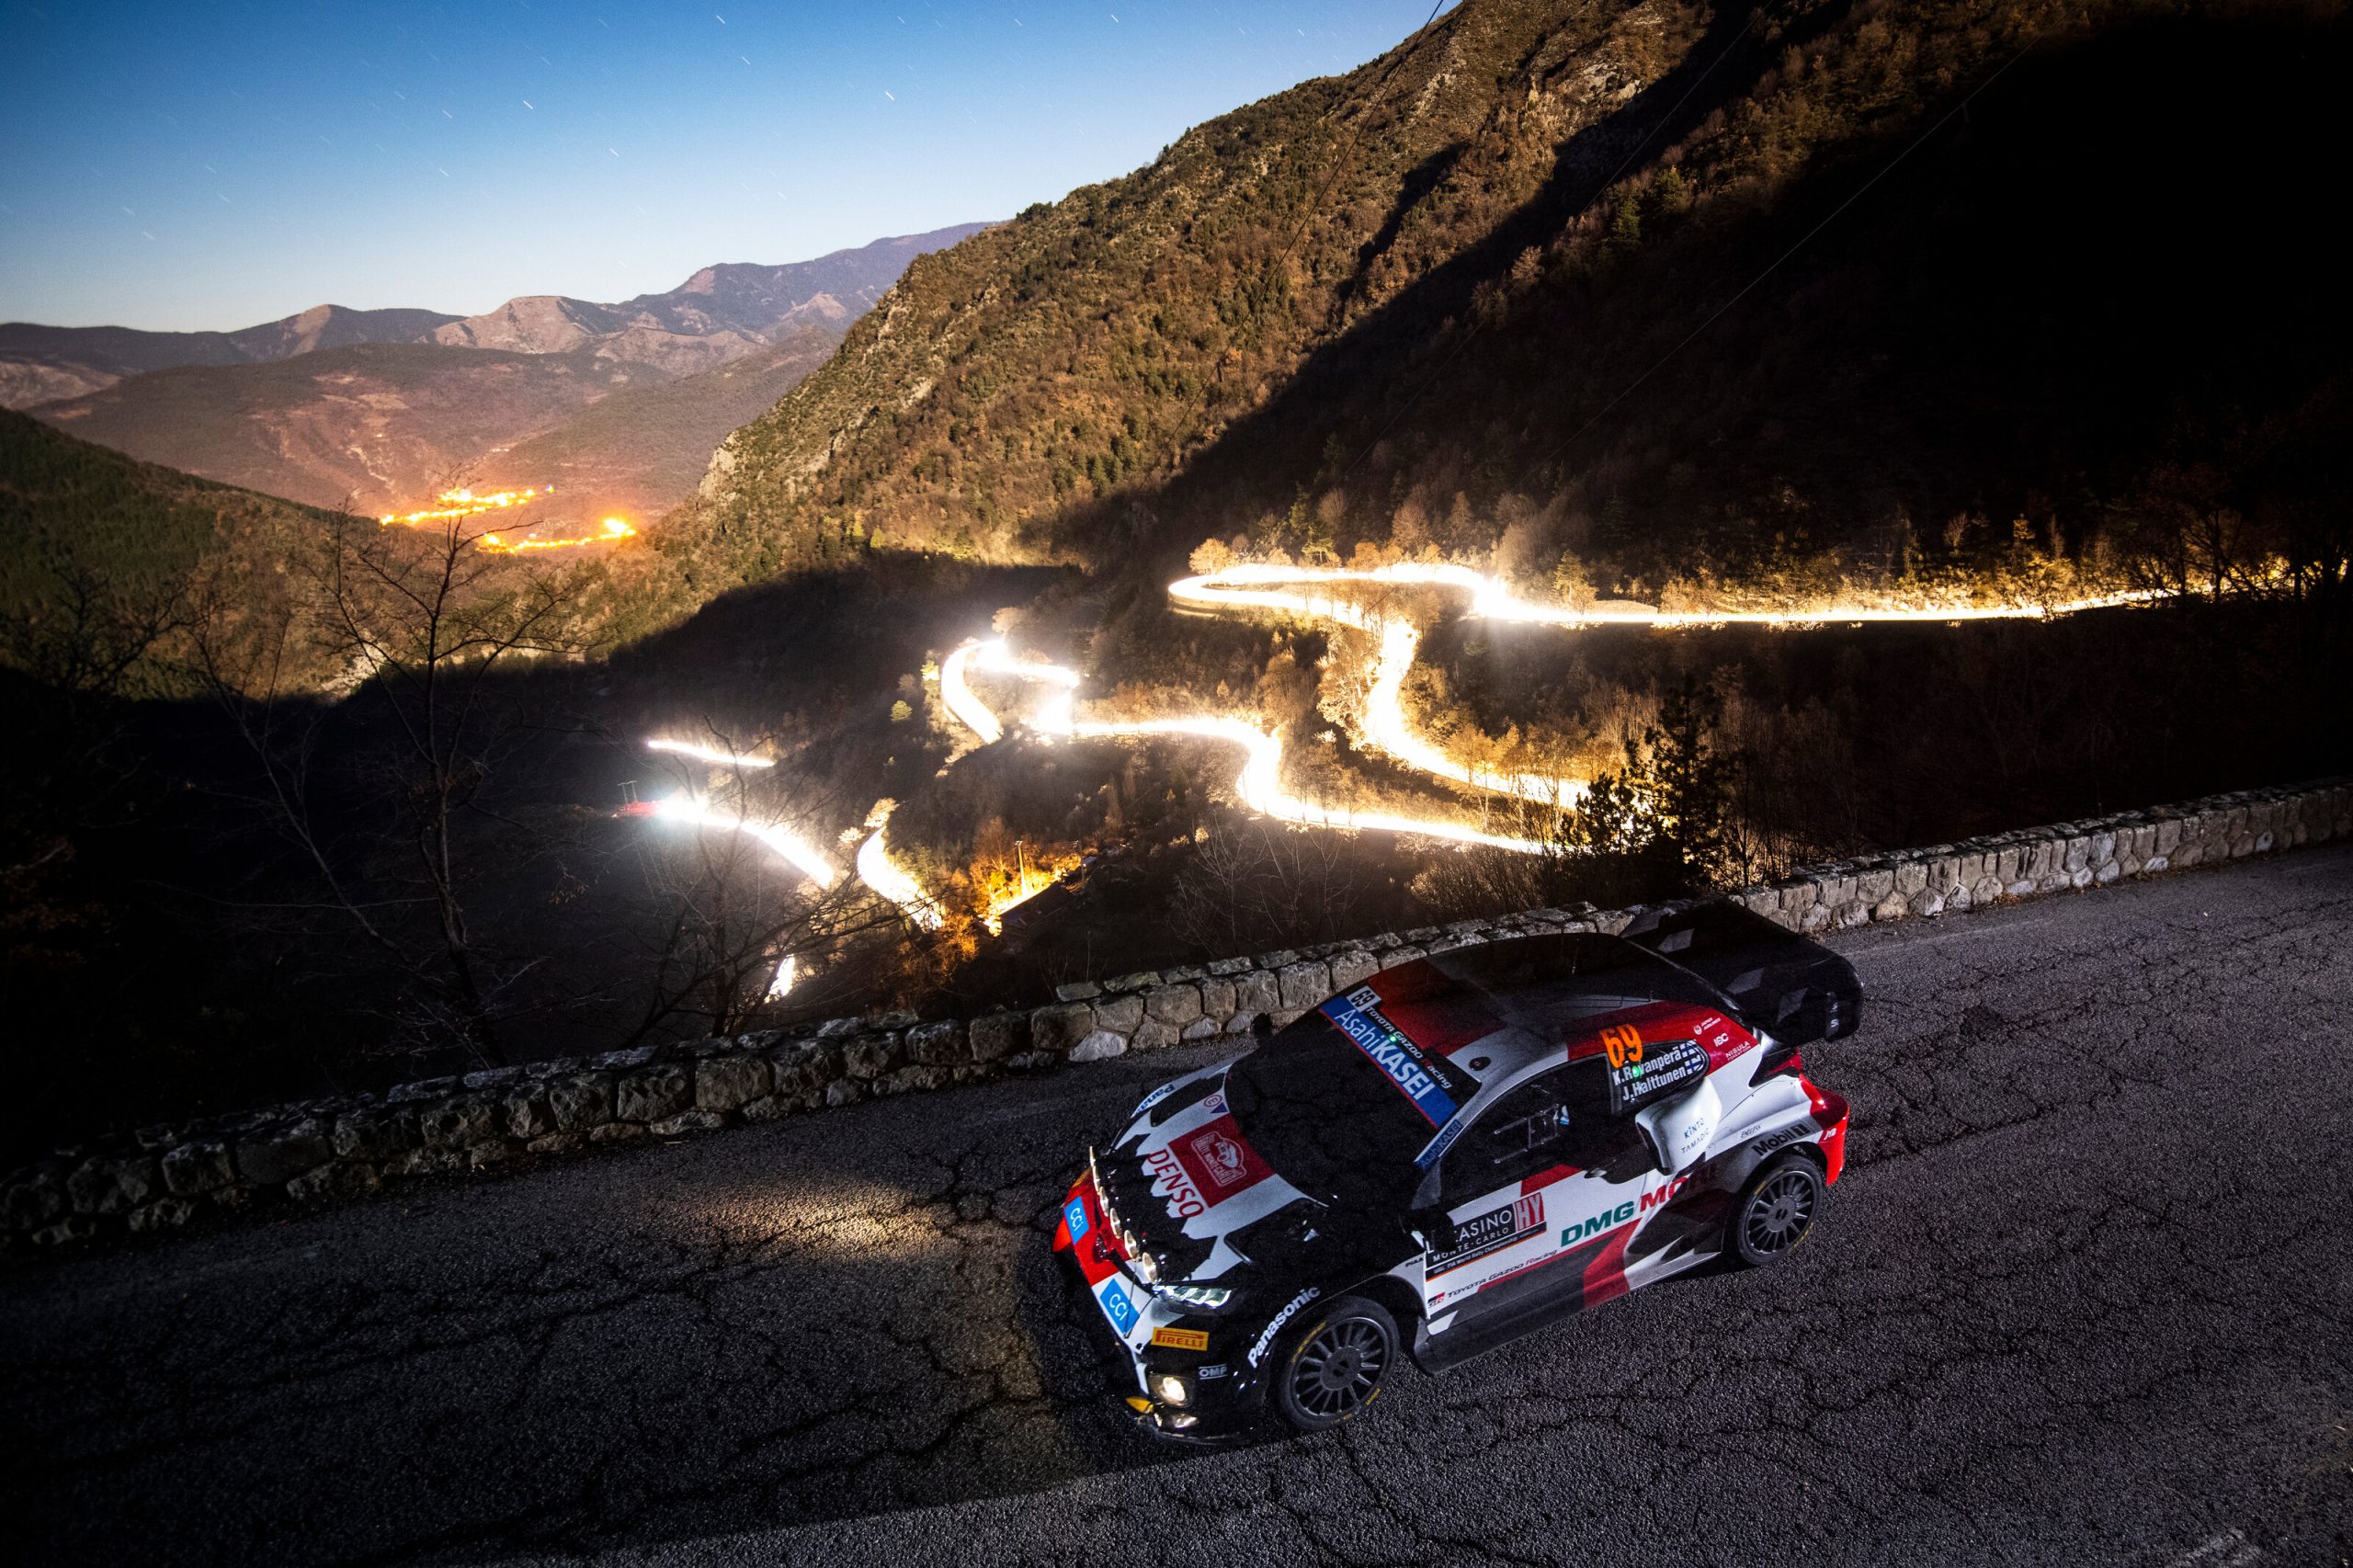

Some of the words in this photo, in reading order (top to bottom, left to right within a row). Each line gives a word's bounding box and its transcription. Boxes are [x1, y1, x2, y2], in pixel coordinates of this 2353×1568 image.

[1350, 989, 1375, 1007] 69
[1366, 1006, 1394, 1032] TOYOTA
[1393, 1031, 1423, 1059] GAZOO
[1422, 1058, 1452, 1089] Racing
[1599, 1023, 1643, 1068] 69
[1725, 1040, 1750, 1058] NISULA
[1753, 1129, 1793, 1156] Mobil
[1147, 1149, 1204, 1218] DENSO
[1454, 1210, 1513, 1243] ASINO
[1517, 1194, 1541, 1232] HY
[1561, 1200, 1634, 1247] DMG
[1448, 1278, 1486, 1298] TOYOTA
[1489, 1263, 1523, 1280] GAZOO
[1526, 1250, 1557, 1266] Racing
[1155, 1329, 1204, 1348] PIRELLI
[1247, 1287, 1321, 1368] Panasonic
[1199, 1366, 1227, 1378] OMP
